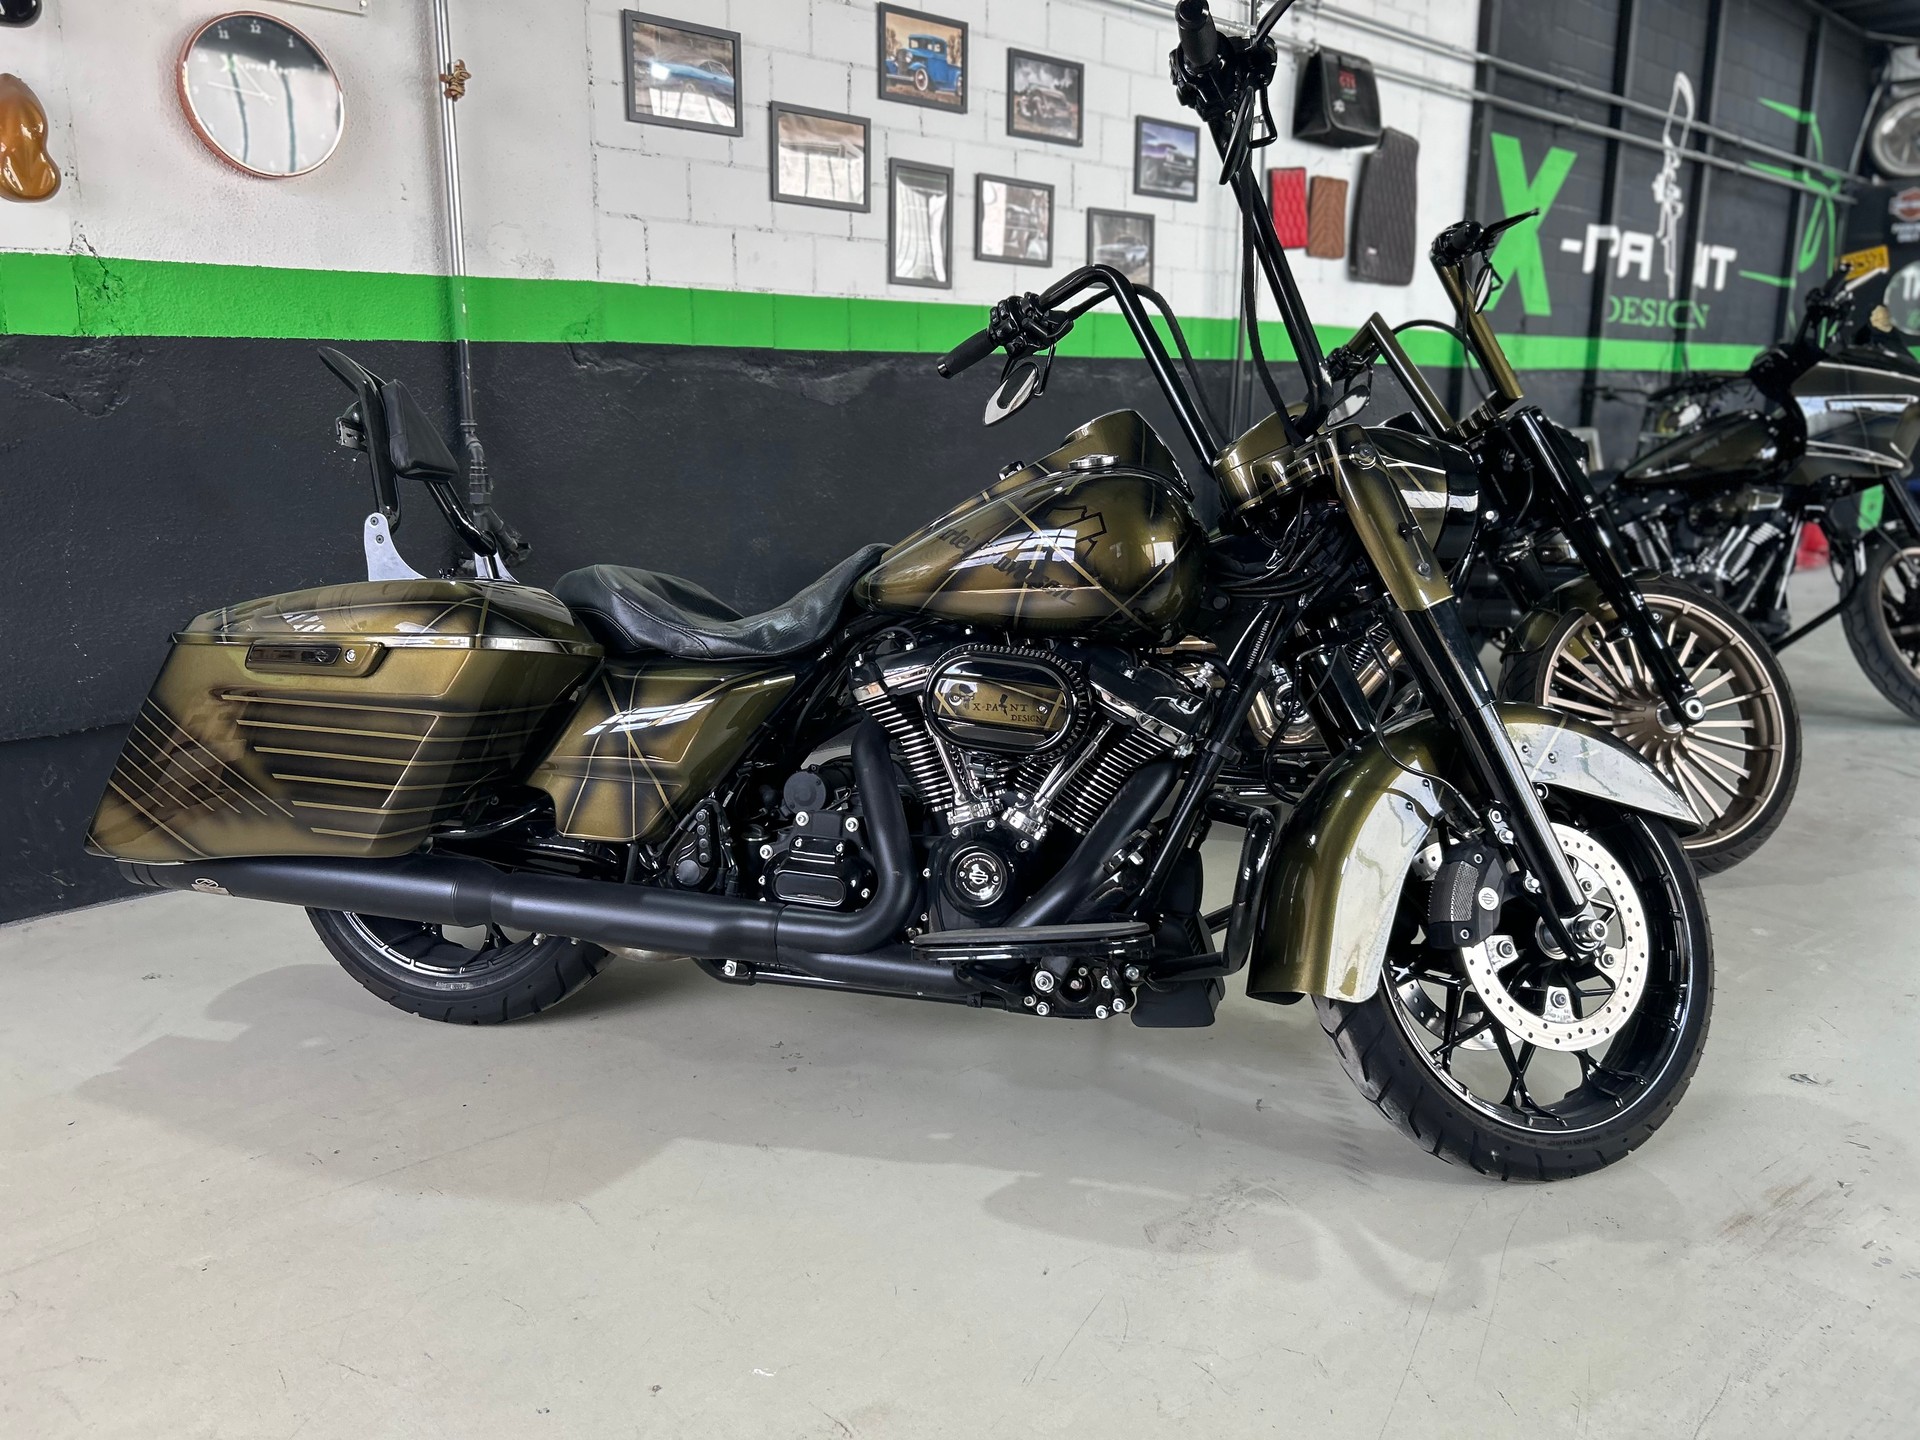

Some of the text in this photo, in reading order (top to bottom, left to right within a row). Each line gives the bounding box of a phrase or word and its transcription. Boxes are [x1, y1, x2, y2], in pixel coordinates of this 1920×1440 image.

[250, 24, 261, 34] 12
[218, 30, 230, 39] 11
[1011, 714, 1043, 723] DESIGN
